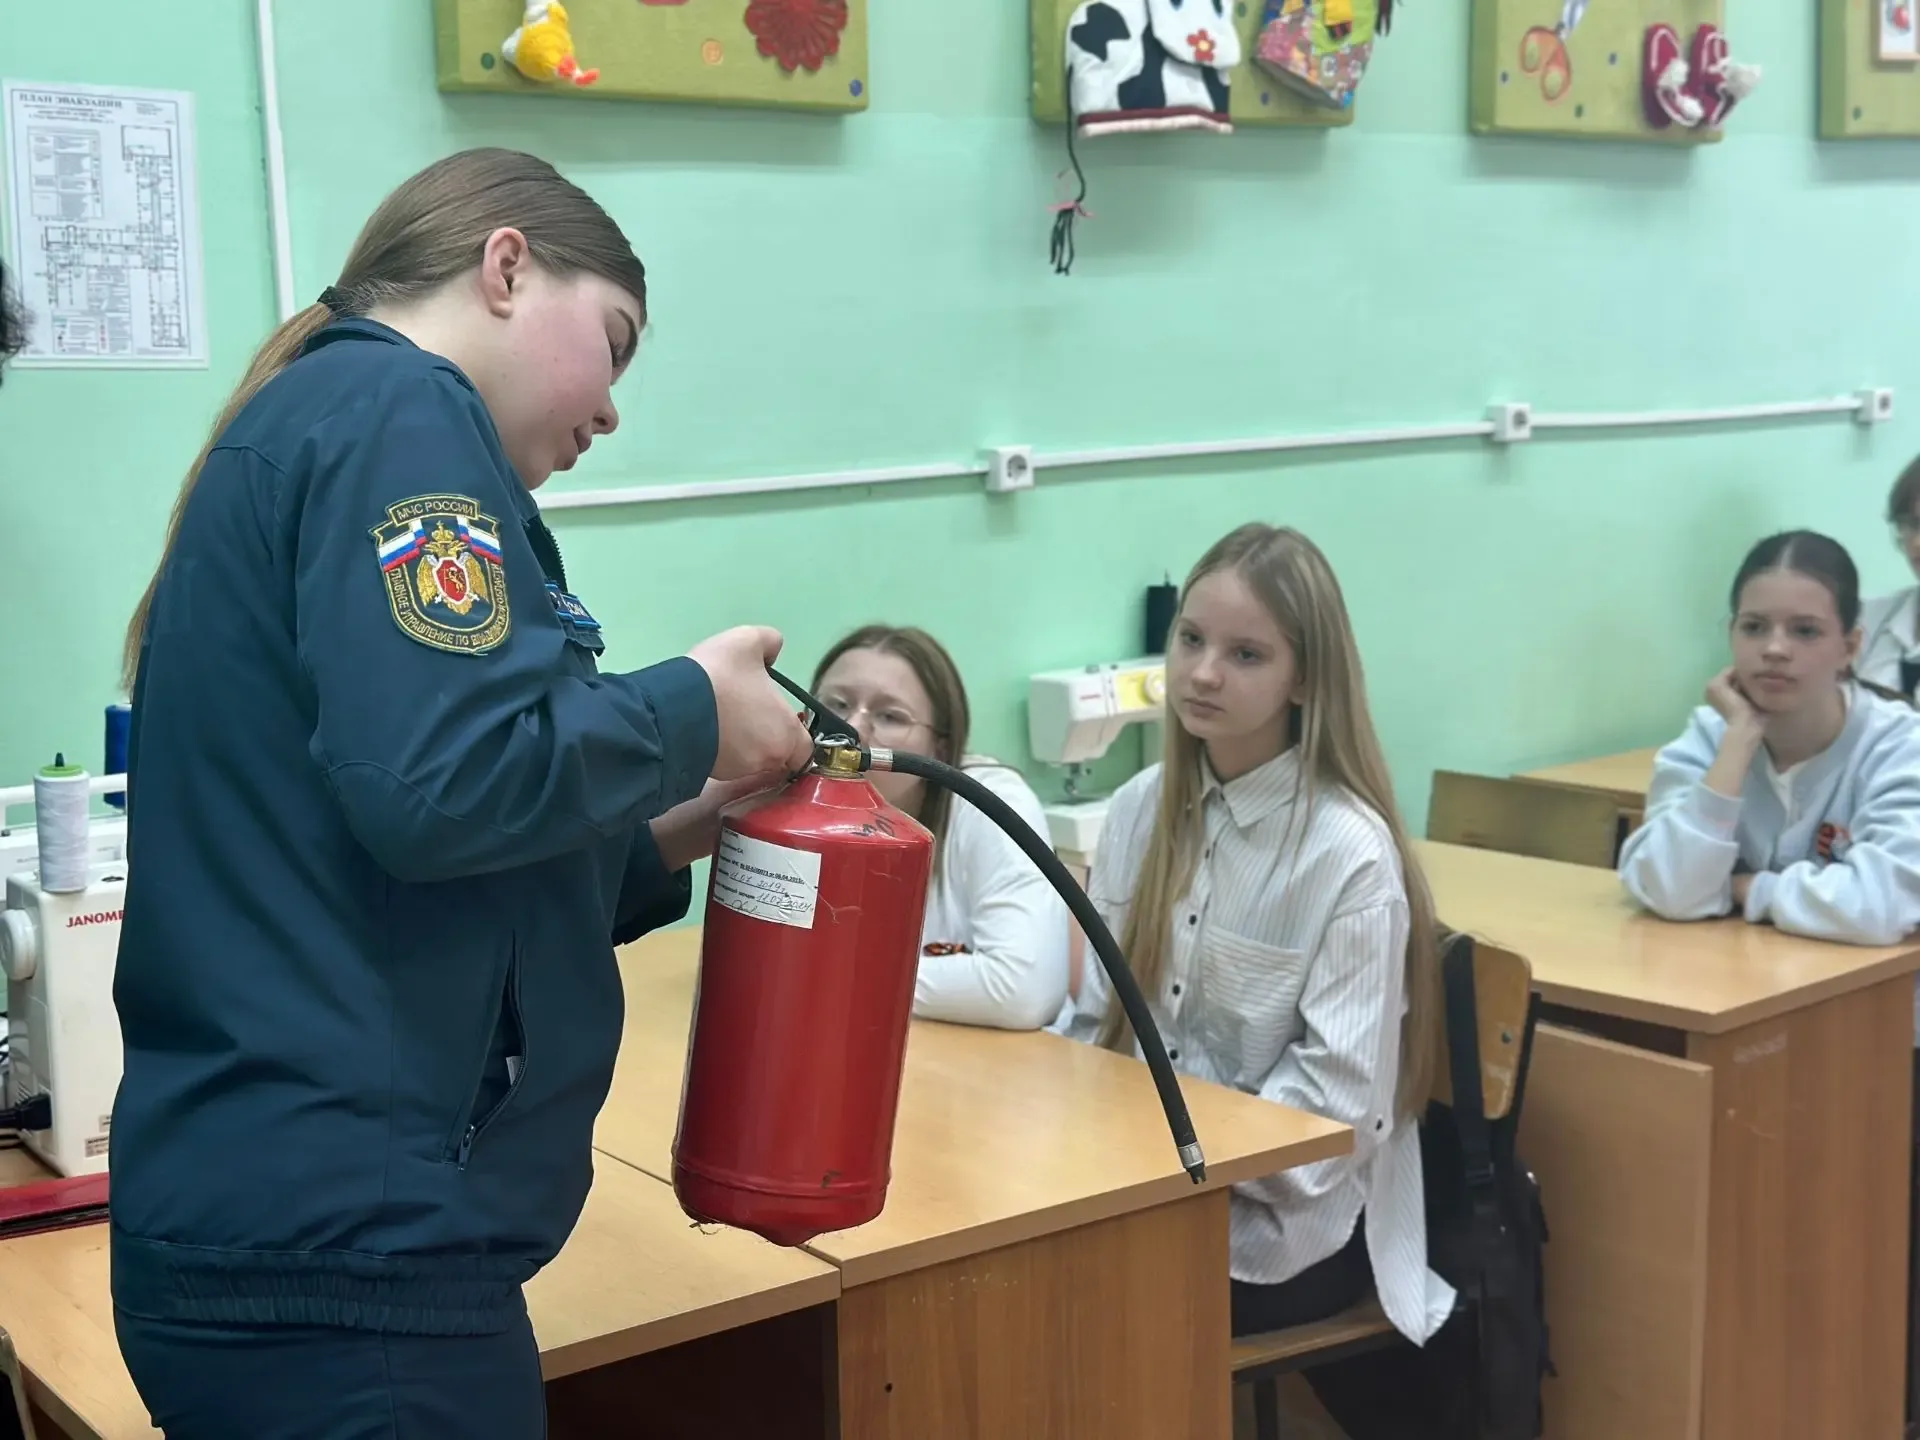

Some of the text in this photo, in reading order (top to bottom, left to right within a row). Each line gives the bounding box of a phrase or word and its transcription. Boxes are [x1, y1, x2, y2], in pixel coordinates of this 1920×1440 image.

[19, 93, 52, 103] ПЛАН
[56, 96, 122, 109] ЭВАКУАЦИИ
[396, 500, 473, 520] МЧС РОССИИ
[390, 568, 410, 609] ГЛАВНОЕ
[400, 609, 456, 644] УПРАВЛЕНИЕ
[455, 634, 469, 646] ПО
